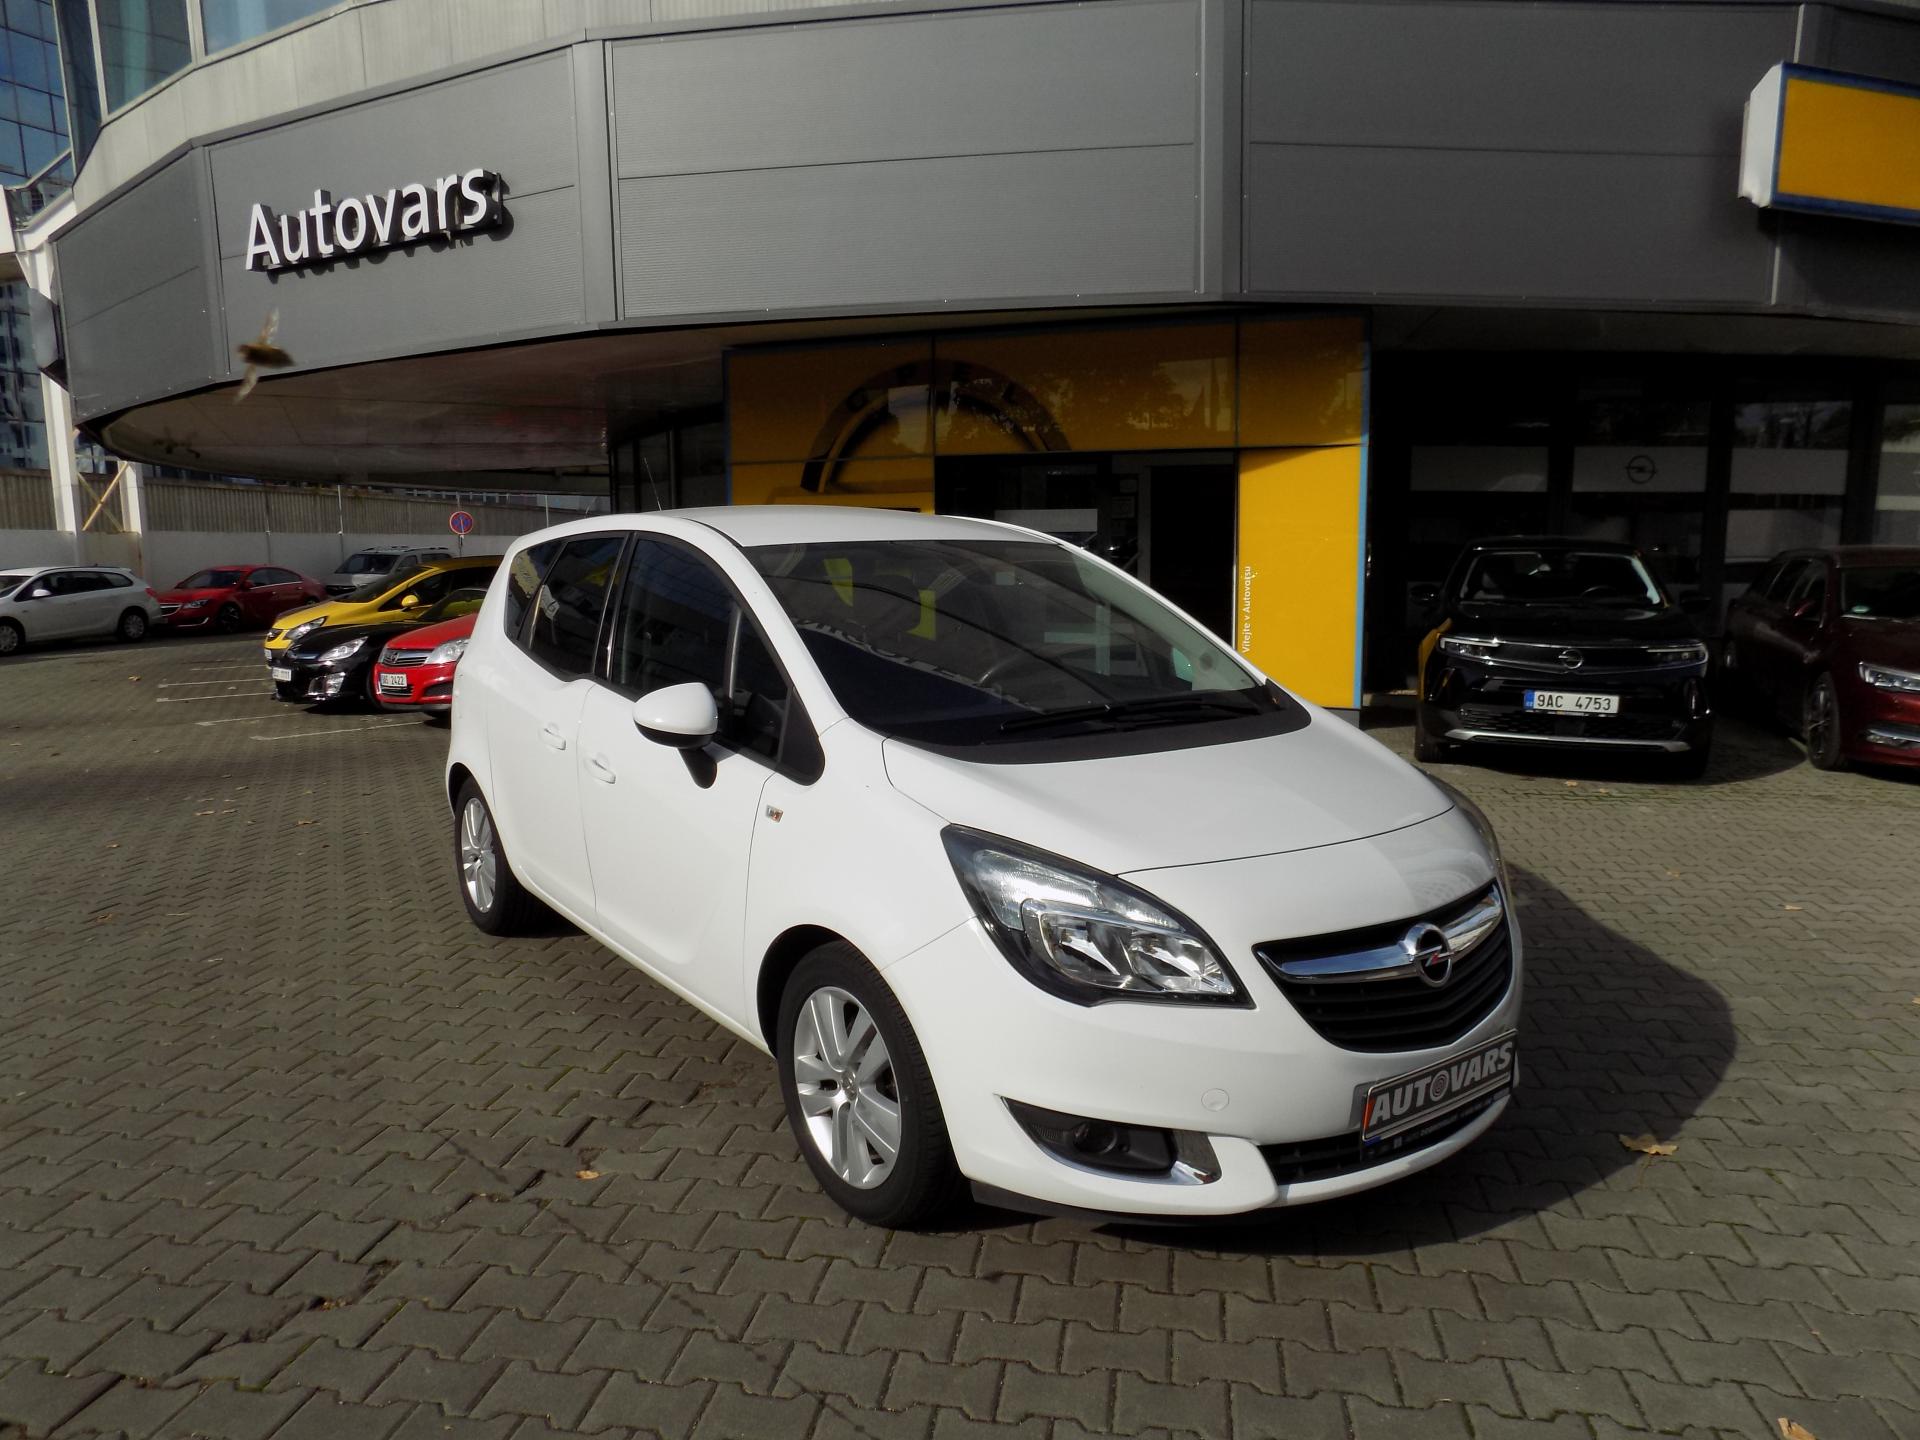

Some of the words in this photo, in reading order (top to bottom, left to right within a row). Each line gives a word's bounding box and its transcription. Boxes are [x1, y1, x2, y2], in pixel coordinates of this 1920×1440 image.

[245, 168, 487, 270] Autovars
[1243, 566, 1252, 613] Autovarsu
[1537, 694, 1564, 708] 9AC
[1575, 696, 1611, 711] 4753
[1368, 1041, 1513, 1126] AUTOVARS
